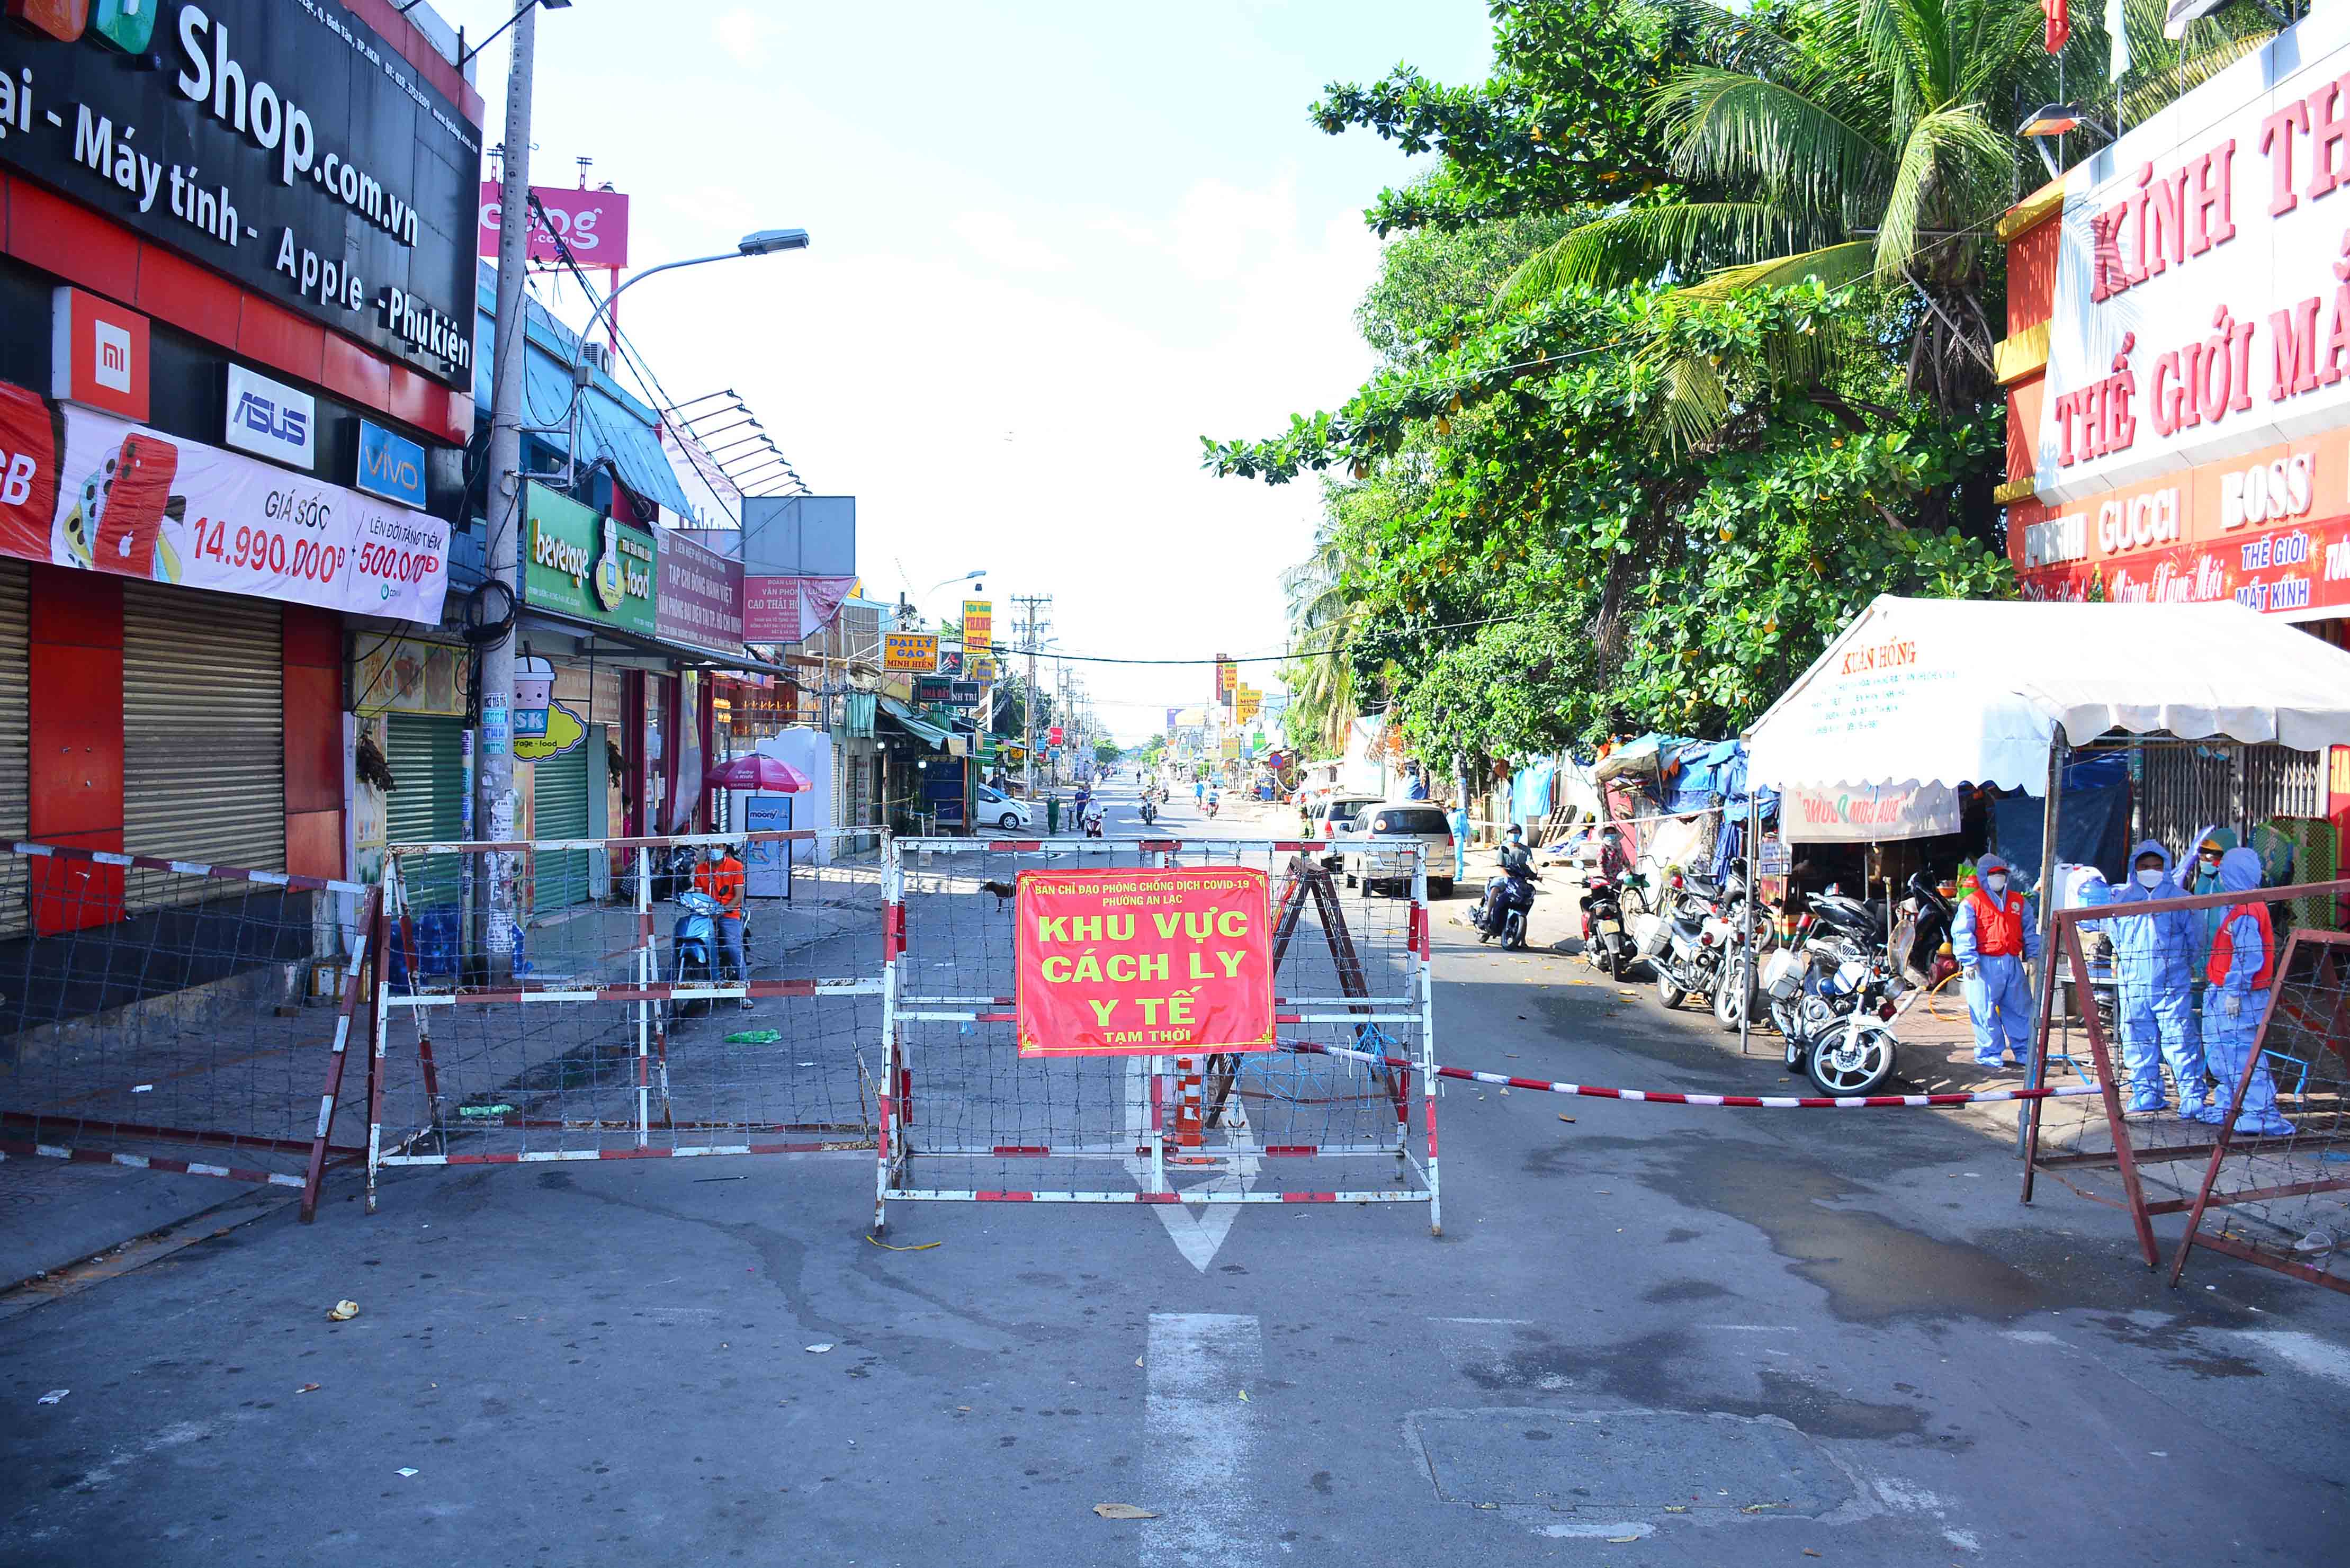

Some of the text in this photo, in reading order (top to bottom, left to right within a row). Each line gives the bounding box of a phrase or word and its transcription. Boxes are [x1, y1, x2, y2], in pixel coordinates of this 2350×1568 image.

[327, 14, 339, 34] Bình
[75, 102, 162, 213] Máy
[170, 167, 237, 247] tính
[276, 227, 362, 312] Apple
[430, 309, 469, 373] kiện
[2091, 139, 2235, 303] KÍNH
[2055, 331, 2136, 467] THẾ
[2150, 304, 2254, 436] GIỚI
[232, 392, 308, 447] ASUS
[0, 449, 36, 507] B
[365, 446, 418, 491] vivo
[265, 488, 331, 531] GIÁ SỐC
[2220, 453, 2315, 531] BOSS
[370, 516, 386, 536] LÊN
[387, 521, 402, 540] ĐỜI
[402, 526, 421, 546] TẶNG
[2098, 488, 2180, 554] GUCCI
[533, 517, 589, 588] beverage
[2242, 530, 2308, 571] THẾ GIỚI
[625, 559, 650, 599] food
[669, 563, 680, 588] TẠP
[720, 583, 733, 606] VIỆT
[779, 587, 798, 596] PHÒN
[2237, 574, 2309, 611] MẮT KÍNH
[748, 599, 764, 609] CAO
[767, 597, 786, 609] THÁI
[965, 617, 991, 631] THANH
[1841, 644, 1874, 675] XUÂN
[513, 740, 533, 749] erage
[750, 809, 778, 820] moony
[1035, 879, 1250, 896] BAN CHỈ ĐẠO PHÒNG CHỐNG DỊCH COVID-19
[1102, 894, 1183, 907] PHƯỜNG AN LẠC
[1038, 906, 1249, 944] KHU VỰC
[1041, 948, 1247, 983] CÁCH LY
[1089, 985, 1203, 1026] Y TẾ
[1104, 1027, 1191, 1044] TẠM THỜI
